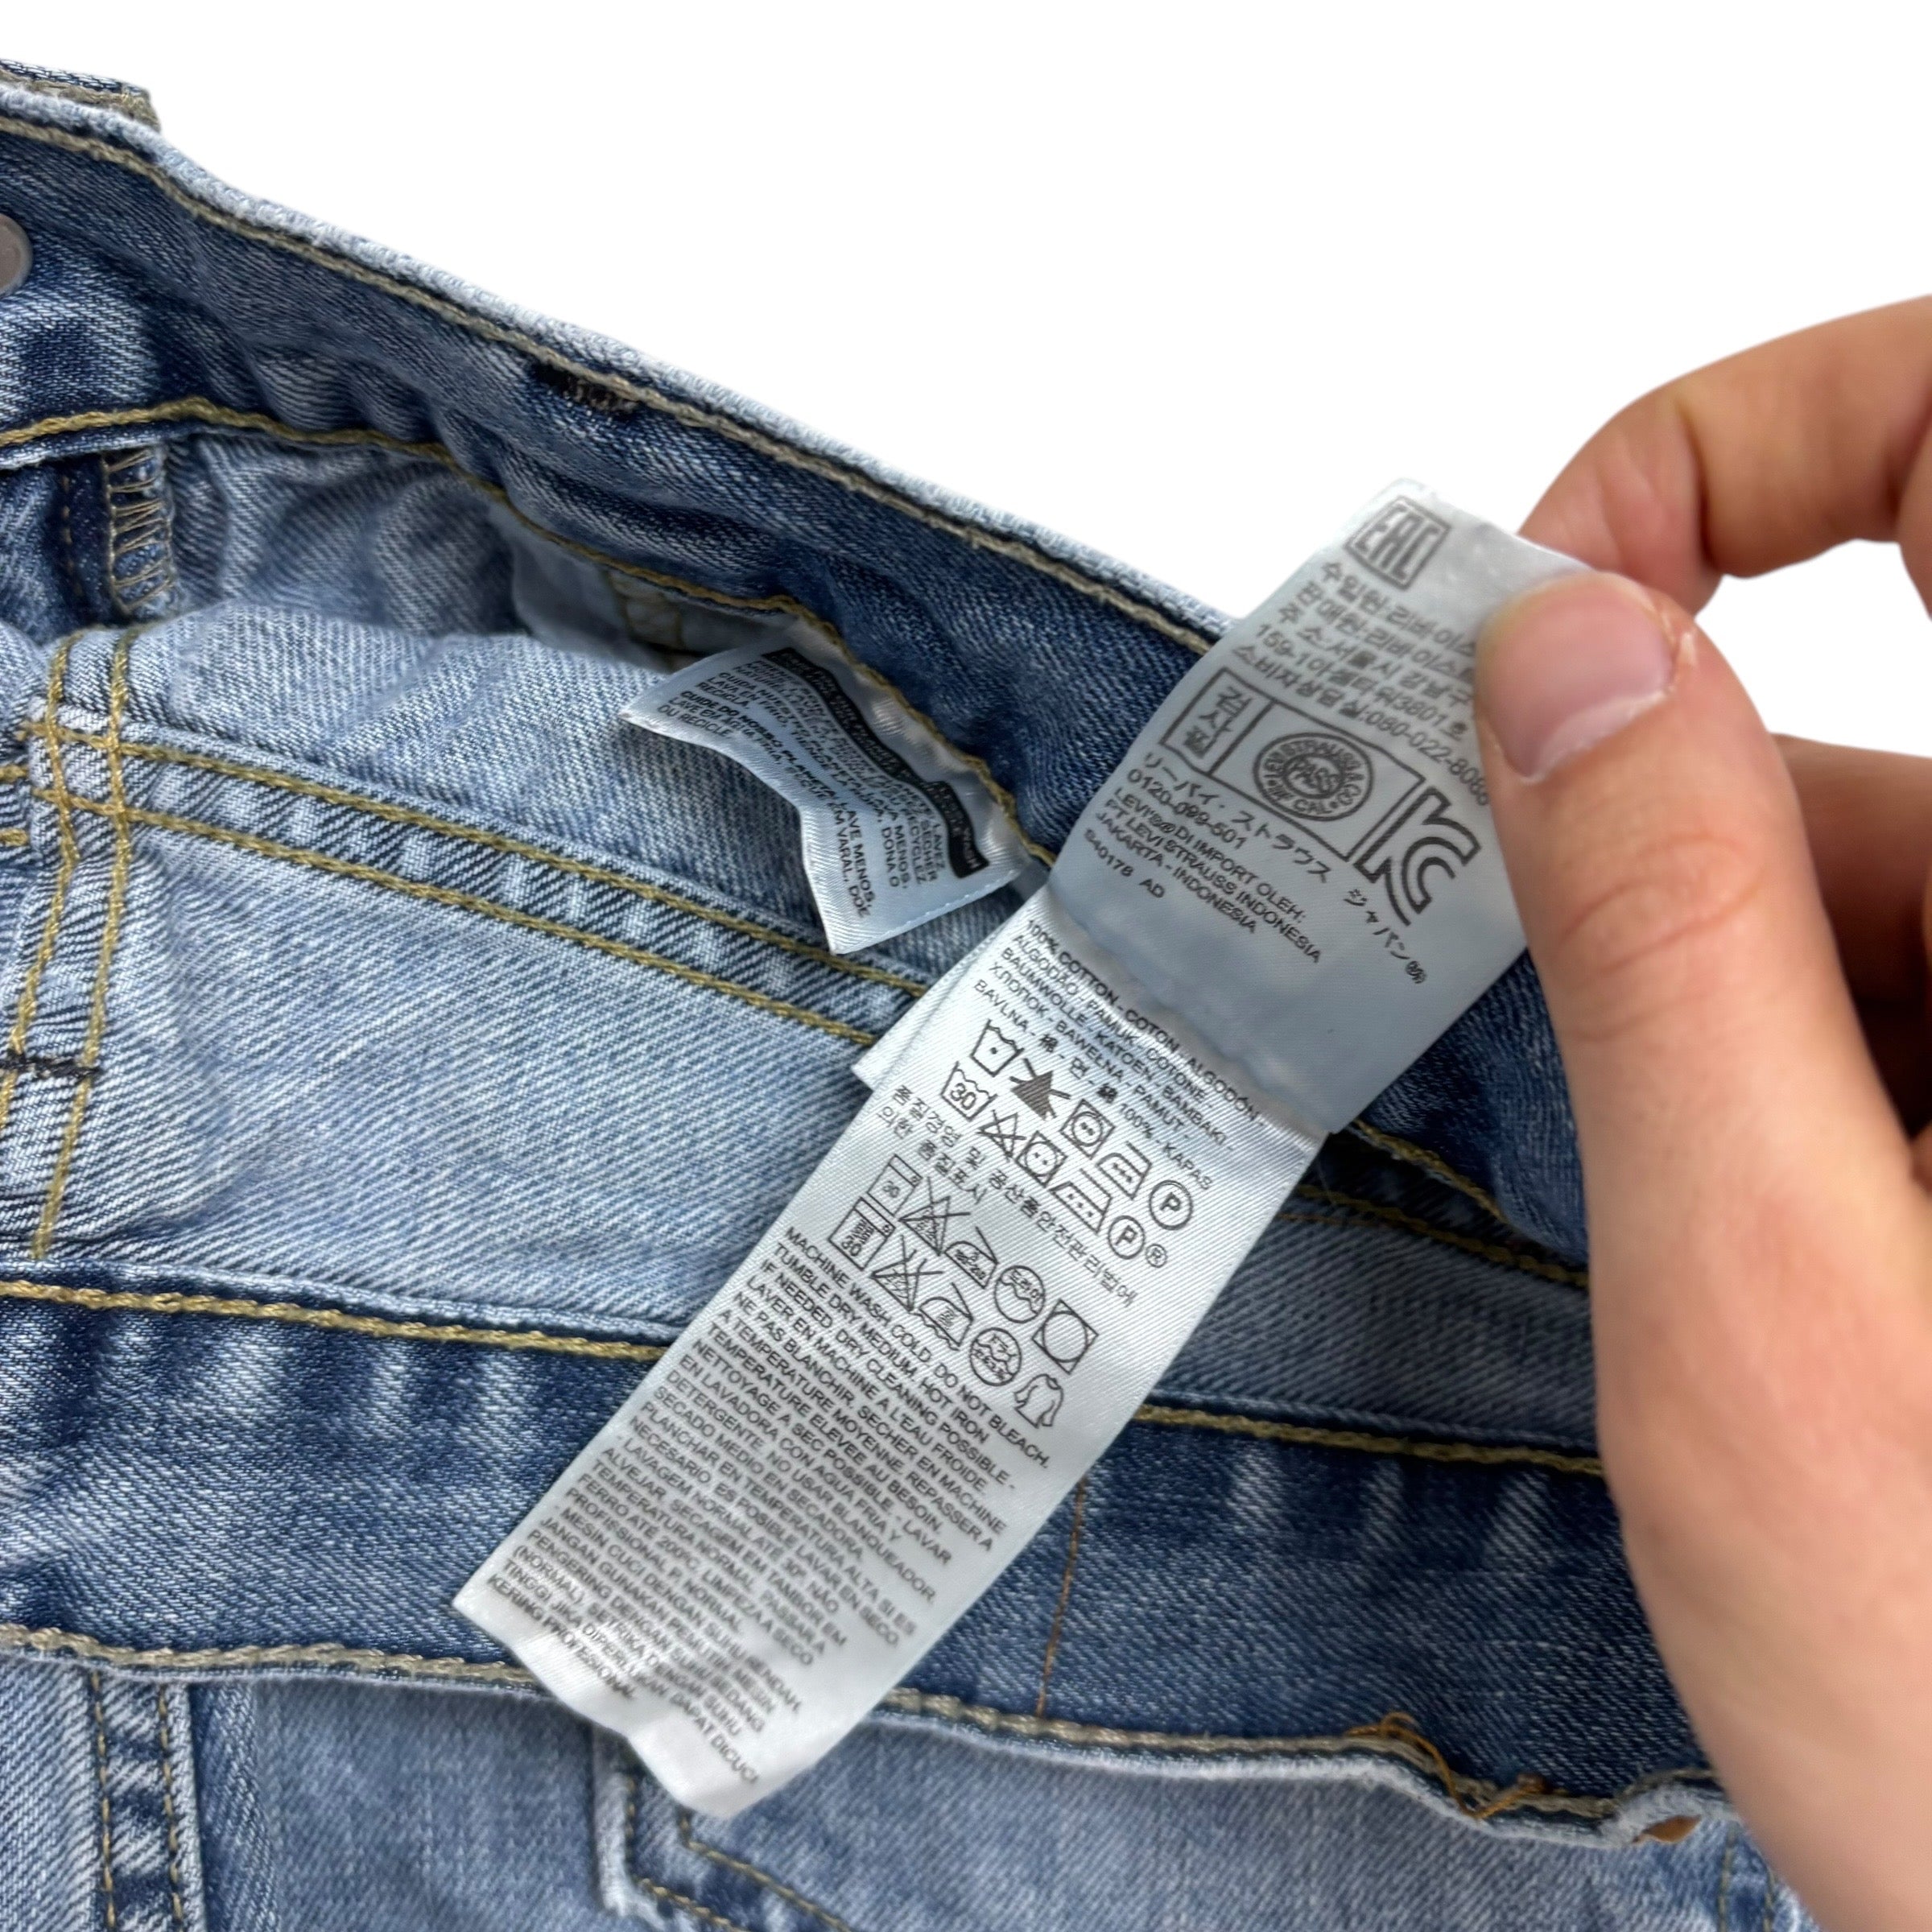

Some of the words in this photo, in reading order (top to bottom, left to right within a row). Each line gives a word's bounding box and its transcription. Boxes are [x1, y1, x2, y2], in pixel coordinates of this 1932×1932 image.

[679, 688, 719, 710] CUIDE
[716, 703, 740, 719] DO
[880, 826, 898, 872] DONA
[1125, 766, 1247, 851] 0120-099-501
[848, 884, 870, 919] DOE
[852, 843, 877, 907] MENOS,
[1093, 809, 1166, 868] JAKARTA
[1170, 865, 1261, 934] INDONESIA
[1103, 799, 1129, 821] PT
[1124, 815, 1165, 848] LEVI
[1162, 838, 1239, 896] STRAUSS
[1234, 890, 1326, 964] INDONESIA
[1139, 875, 1167, 900] AD
[1190, 837, 1257, 889] IMPORT
[1253, 881, 1308, 924] OLEH:
[972, 978, 1033, 1031] BAVLNA
[999, 945, 1089, 1028] BAUMWOLLE
[1092, 1028, 1158, 1084] KATOEN
[1160, 1085, 1228, 1146] BAMBAKI
[1009, 932, 1084, 997] ALGODÃO
[1084, 997, 1140, 1046] PAMUK
[1142, 1046, 1210, 1104] COTONE
[1021, 919, 1062, 955] 100%
[1055, 948, 1121, 1006] COTTON
[1123, 1005, 1181, 1056] COTON
[947, 1080, 980, 1112] 30
[1116, 1101, 1158, 1140] 100%
[1160, 1141, 1213, 1191] KAPAS
[1130, 1083, 1187, 1133] PAMUT
[840, 1234, 864, 1258] 30
[1157, 1191, 1184, 1219] P
[706, 1323, 811, 1418] TEMPERATURE
[808, 1412, 867, 1467] ELEVEE
[864, 1459, 889, 1484] AU
[745, 1275, 795, 1321] LAVER
[791, 1317, 815, 1340] EN
[811, 1335, 881, 1401] MACHINE
[875, 1394, 893, 1412] A
[889, 1406, 933, 1447] L'EAU
[758, 1259, 778, 1278] IF
[833, 1328, 868, 1360] DRY
[864, 1356, 940, 1426] CLEANING
[936, 1421, 1010, 1485] POSSIBLE
[770, 1242, 832, 1299] TUMBLE
[827, 1293, 861, 1326] DRY
[856, 1321, 923, 1383] MEDIUM.
[917, 1377, 954, 1412] HOT
[949, 1406, 990, 1445] IRON
[783, 1226, 850, 1289] MACHINE
[848, 1285, 894, 1327] WASH
[932, 1362, 960, 1389] DO
[956, 1385, 993, 1419] NOT
[988, 1413, 1052, 1469] BLEACH.
[652, 1385, 716, 1439] SECADO
[714, 1431, 766, 1478] MEDIO
[762, 1470, 787, 1494] EN
[677, 1352, 704, 1378] EN
[700, 1372, 782, 1443] LAVADORA
[778, 1435, 814, 1468] CON
[811, 1462, 857, 1503] AGUA
[852, 1497, 891, 1533] FRIA
[887, 1530, 902, 1545] Y
[691, 1338, 781, 1415] NETTOYAGE
[777, 1410, 794, 1427] A
[790, 1420, 824, 1453] SEC
[901, 1518, 952, 1566] LAVAR
[717, 1307, 735, 1324] A
[729, 1316, 836, 1414] TEMPERATURE
[904, 1470, 984, 1542] REPASSER
[978, 1534, 996, 1552] A
[733, 1292, 758, 1317] NE
[753, 1311, 786, 1343] PAS
[856, 1403, 919, 1462] SECHER
[915, 1455, 941, 1480] EN
[937, 1474, 1007, 1535] MACHINE
[564, 1485, 671, 1573] PROFISSIONAL
[621, 1436, 693, 1496] LAVAGEM
[691, 1488, 754, 1540] NORMAL
[750, 1530, 785, 1563] ATÉ
[804, 1579, 844, 1615] NÃO
[639, 1400, 722, 1467] PLANCHAR
[717, 1459, 744, 1484] EN
[740, 1476, 848, 1568] TEMPERATURA
[840, 1563, 884, 1603] ALTA
[877, 1597, 897, 1618] SI
[765, 1448, 793, 1475] NO
[790, 1467, 835, 1507] USAR
[486, 1571, 547, 1622] KERING
[500, 1558, 554, 1604] TINGGI
[550, 1596, 585, 1629] JIKA
[525, 1527, 613, 1601] PENGERING
[608, 1594, 675, 1651] DENGAN
[539, 1513, 601, 1565] JANGAN
[596, 1558, 671, 1622] GUNAKAN
[559, 1505, 609, 1549] MESIN
[605, 1542, 646, 1578] CUCI
[641, 1571, 708, 1627] DENGAN
[576, 1471, 631, 1518] FERRO
[625, 1508, 660, 1540] ATÉ
[700, 1567, 766, 1624] LIMPEZA
[759, 1616, 776, 1633] A
[770, 1627, 817, 1667] SECO
[588, 1459, 698, 1547] TEMPERATURA
[758, 1588, 818, 1645] PASSAR
[811, 1637, 829, 1654] A
[667, 1496, 745, 1556] SECAGEM
[741, 1549, 769, 1575] EM
[765, 1567, 827, 1625] TAMBOR
[819, 1619, 850, 1648] EM
[712, 1480, 738, 1505] ES
[734, 1496, 799, 1550] POSIBLE
[792, 1543, 844, 1591] LAVAR
[836, 1583, 864, 1610] EN
[584, 1600, 650, 1657] SETRIKA
